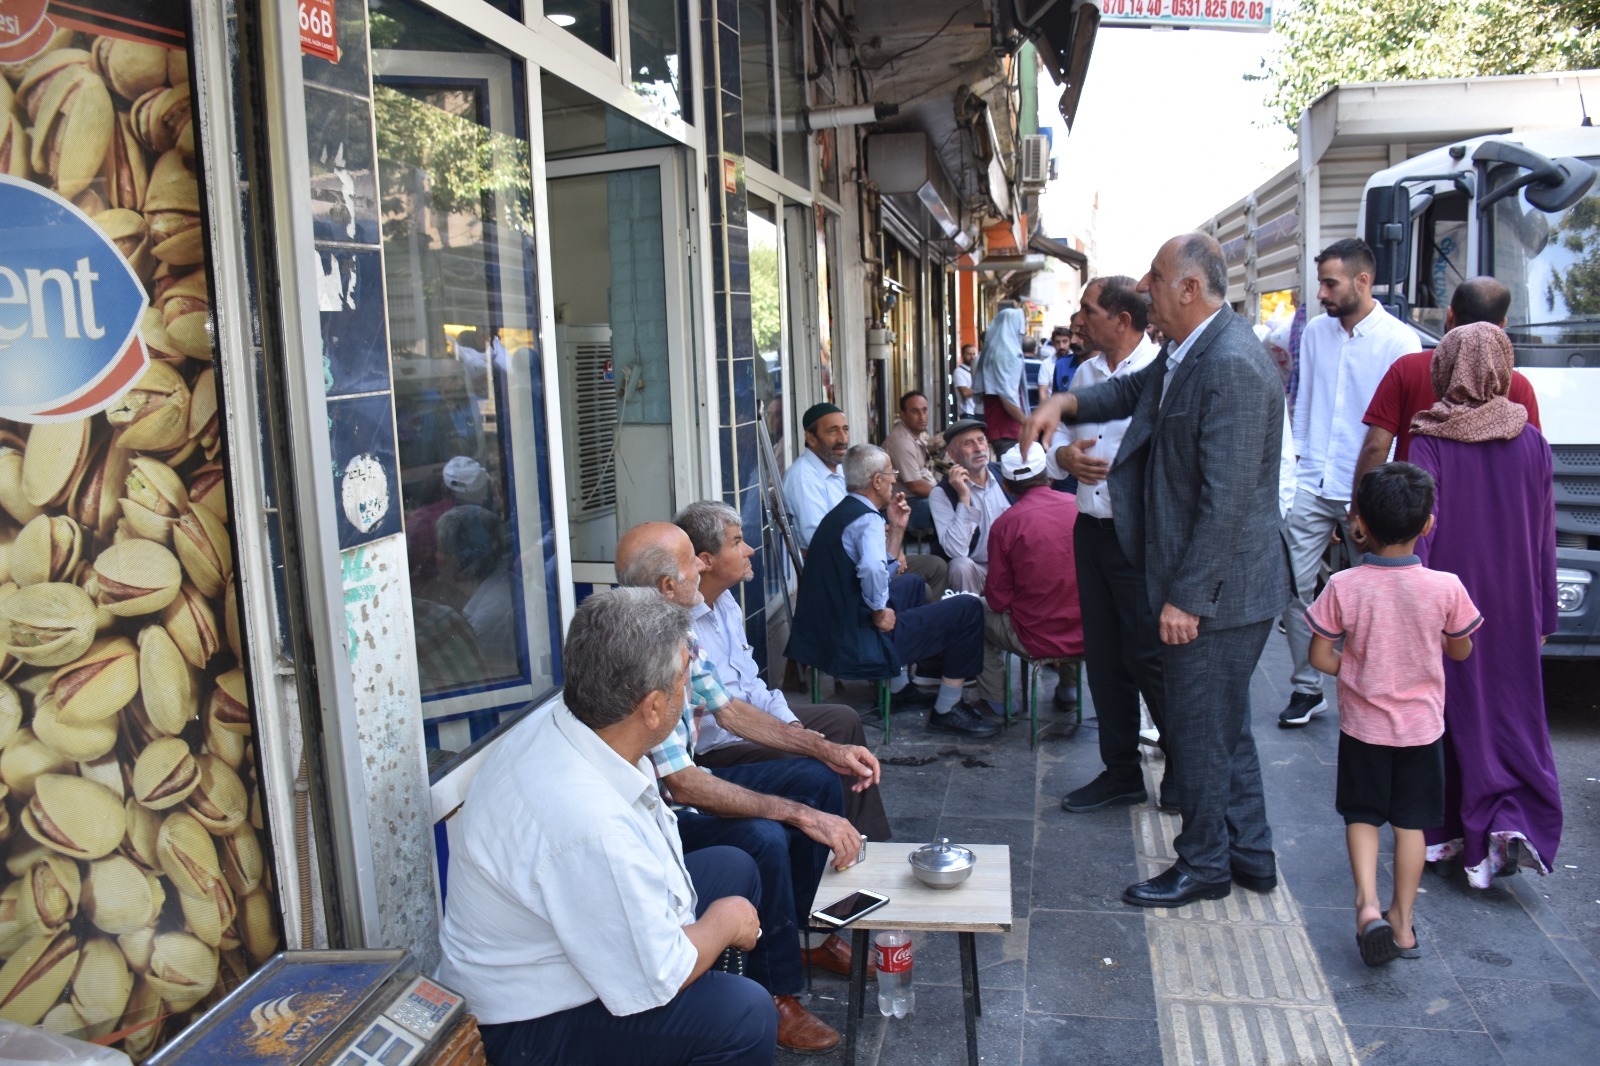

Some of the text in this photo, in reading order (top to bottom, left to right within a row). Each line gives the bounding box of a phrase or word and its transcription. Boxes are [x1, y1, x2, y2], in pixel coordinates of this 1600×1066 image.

[299, 2, 333, 38] 66B
[1131, 0, 1143, 15] 14
[1147, 0, 1161, 15] 40
[1205, 0, 1227, 18] 825
[1231, 1, 1245, 19] 02
[1249, 1, 1264, 20] 03
